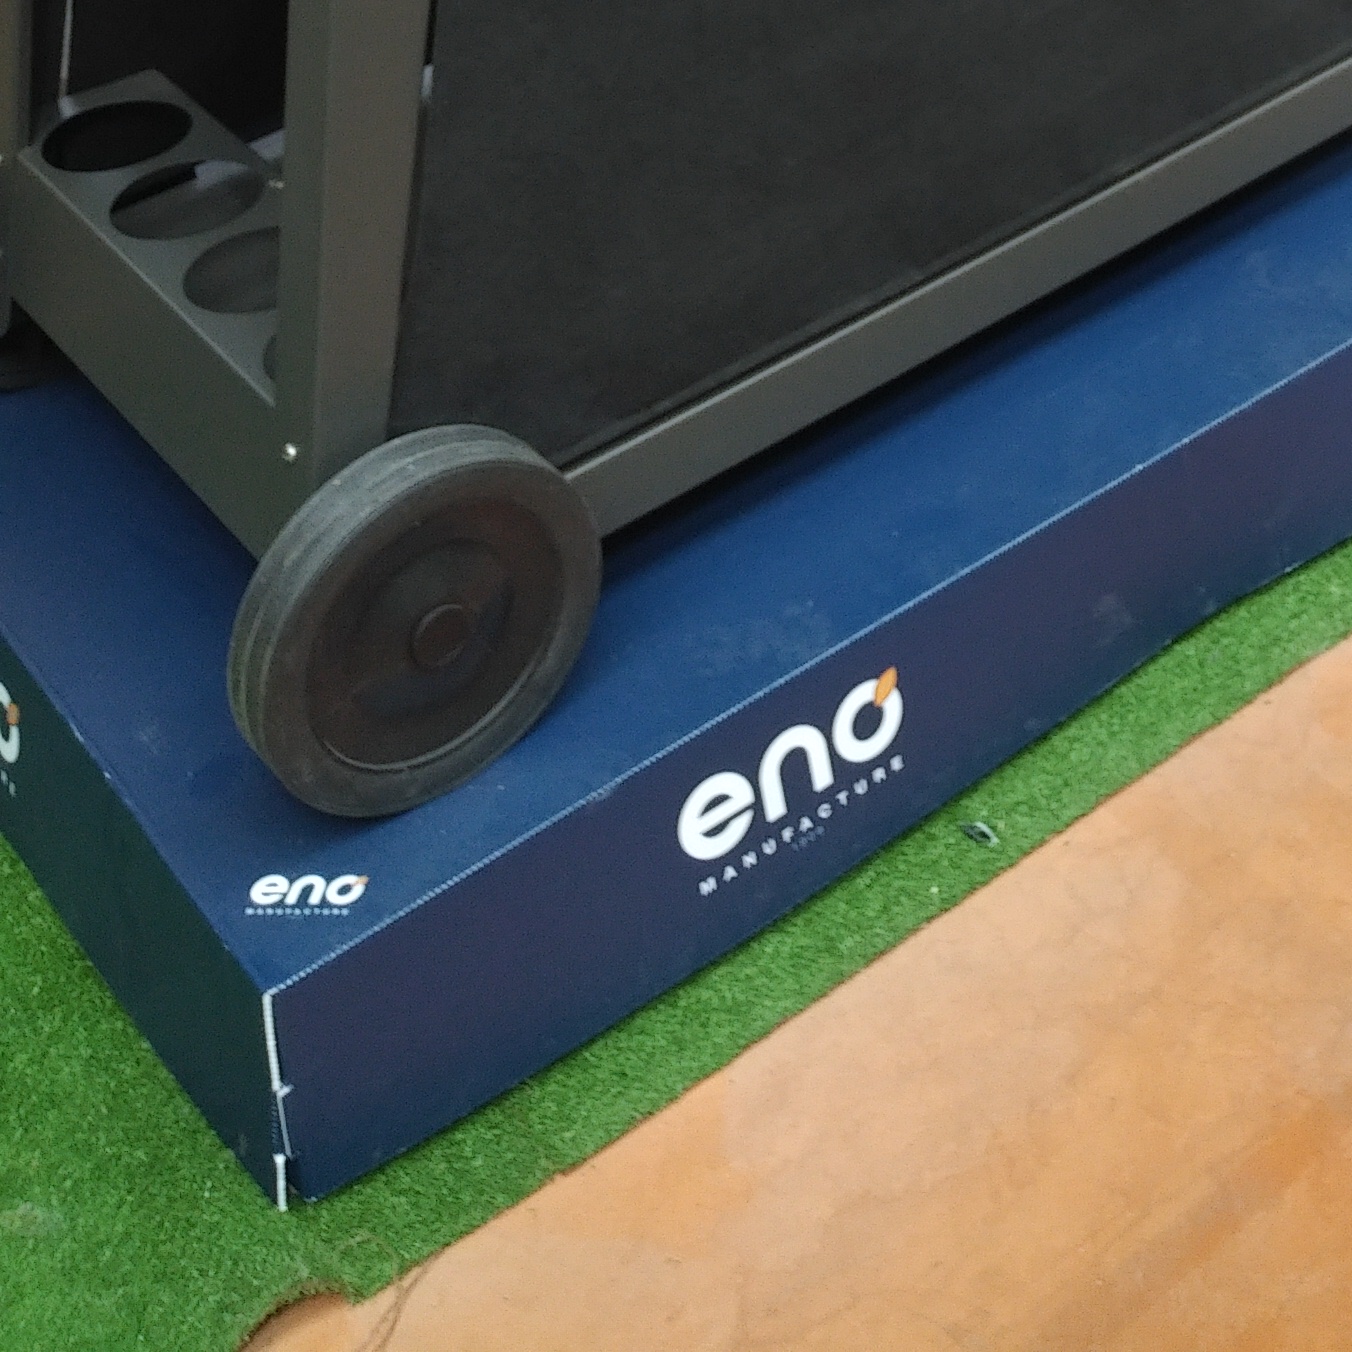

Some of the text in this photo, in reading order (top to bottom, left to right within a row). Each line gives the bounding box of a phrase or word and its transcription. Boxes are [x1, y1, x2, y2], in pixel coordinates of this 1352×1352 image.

[677, 666, 904, 861] eno
[698, 754, 905, 897] MANUFACTURE
[249, 874, 369, 906] eno
